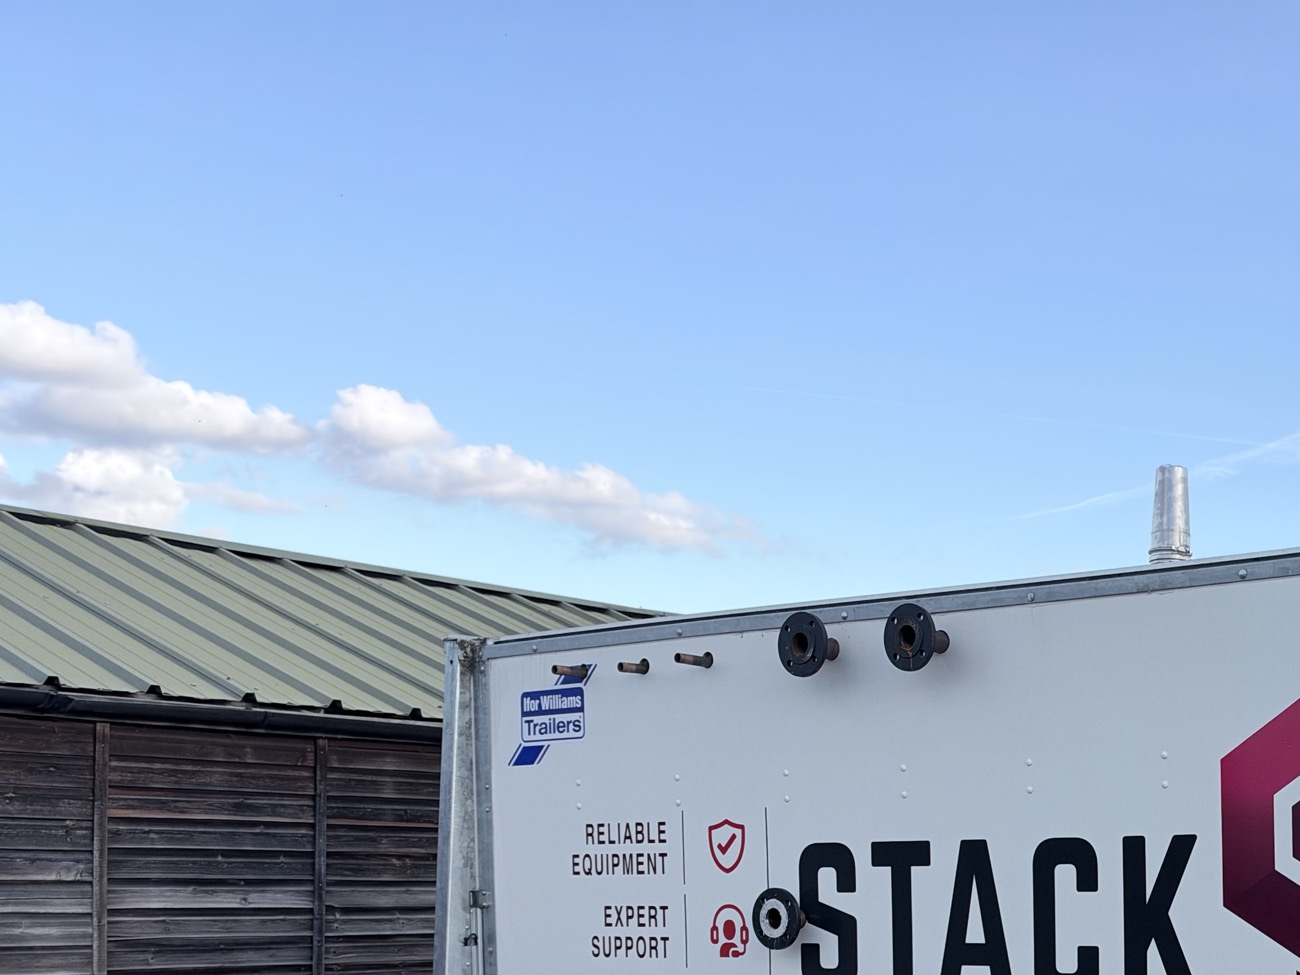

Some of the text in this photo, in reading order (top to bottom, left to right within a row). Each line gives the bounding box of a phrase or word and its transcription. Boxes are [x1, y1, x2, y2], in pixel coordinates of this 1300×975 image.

[523, 694, 582, 712] Ifor Williams
[524, 717, 582, 736] Trailers
[585, 821, 668, 845] RELIABLE
[572, 853, 668, 876] EQUIPMENT
[603, 905, 669, 928] EXPERT
[591, 936, 670, 959] SUPPORT
